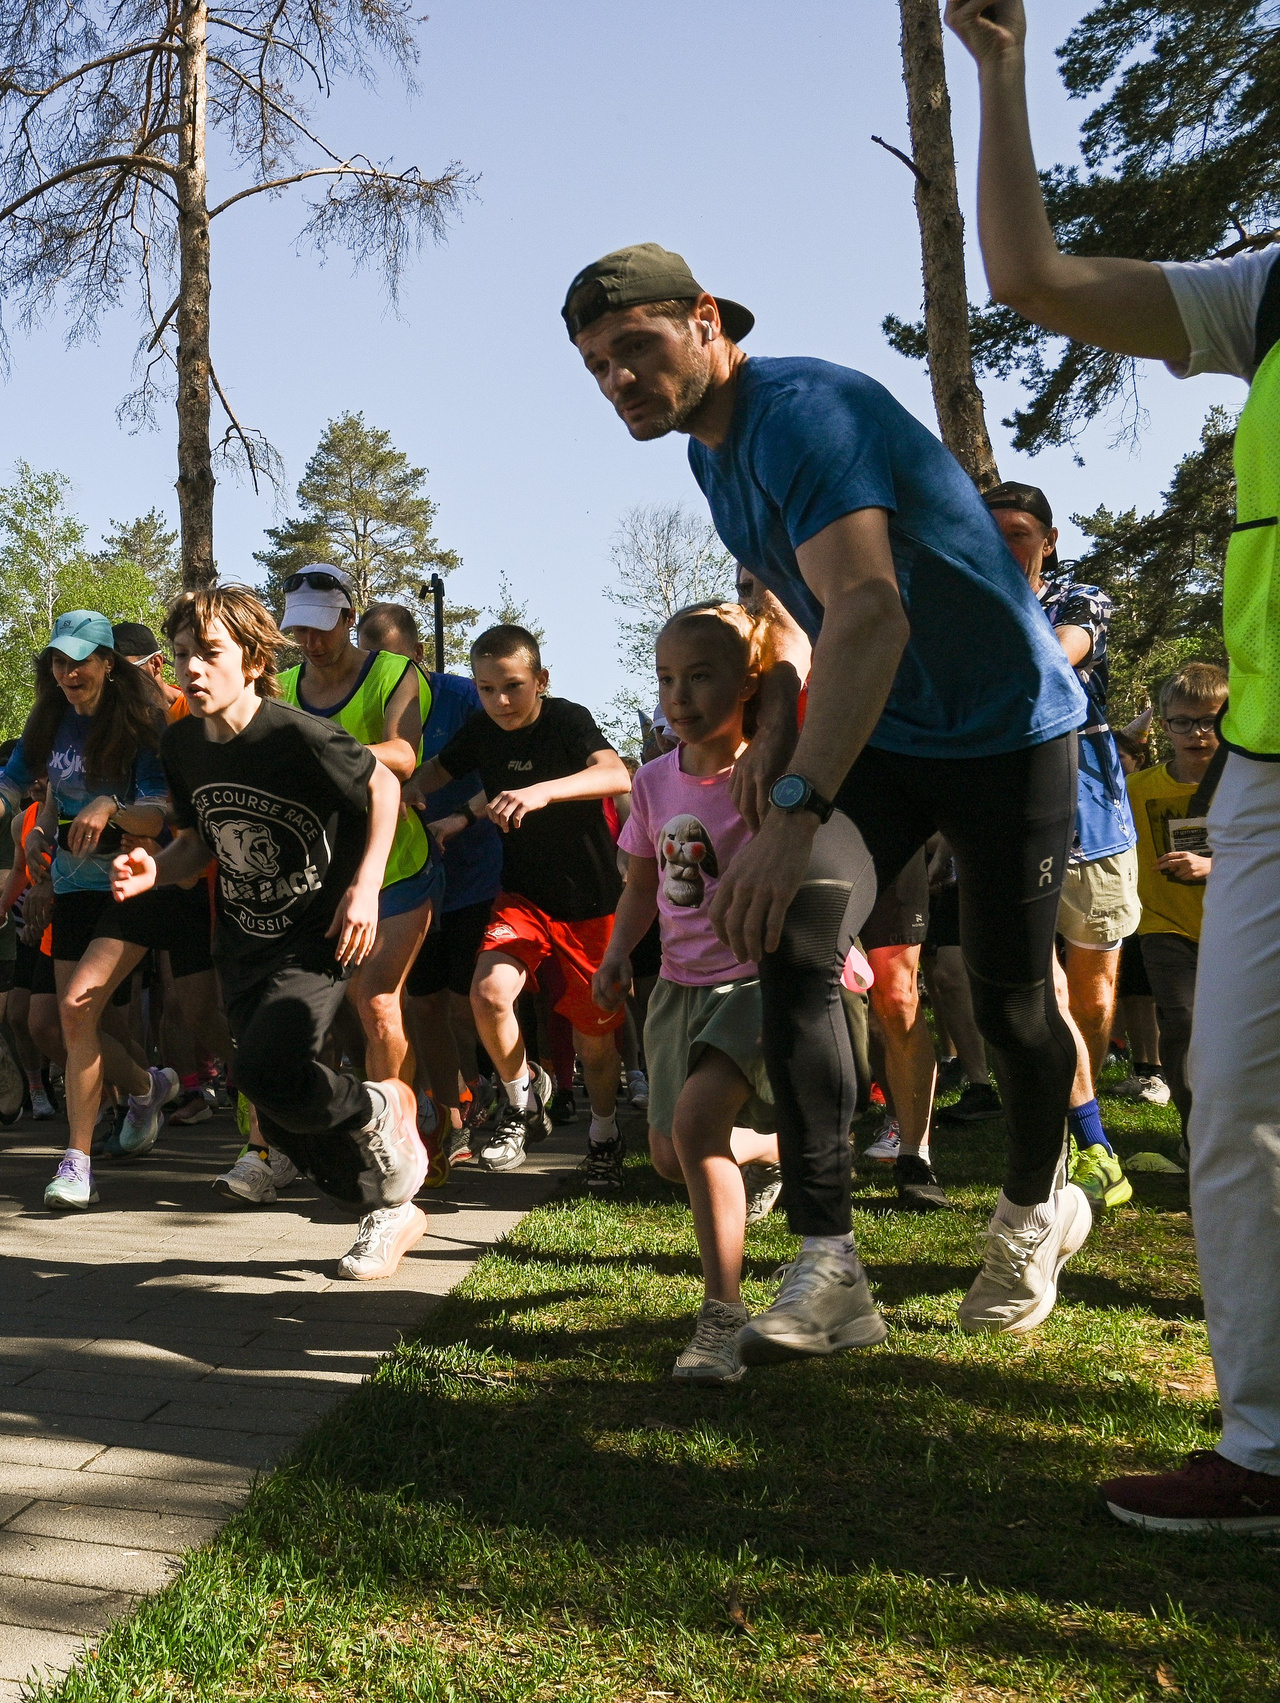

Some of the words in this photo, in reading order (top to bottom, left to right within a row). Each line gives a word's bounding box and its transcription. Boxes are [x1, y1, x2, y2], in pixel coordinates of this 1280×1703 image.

[508, 760, 533, 770] FILA
[212, 790, 282, 816] COURSE
[284, 808, 319, 842] RACE
[259, 865, 323, 903] RACE
[239, 910, 294, 932] RUSSIA
